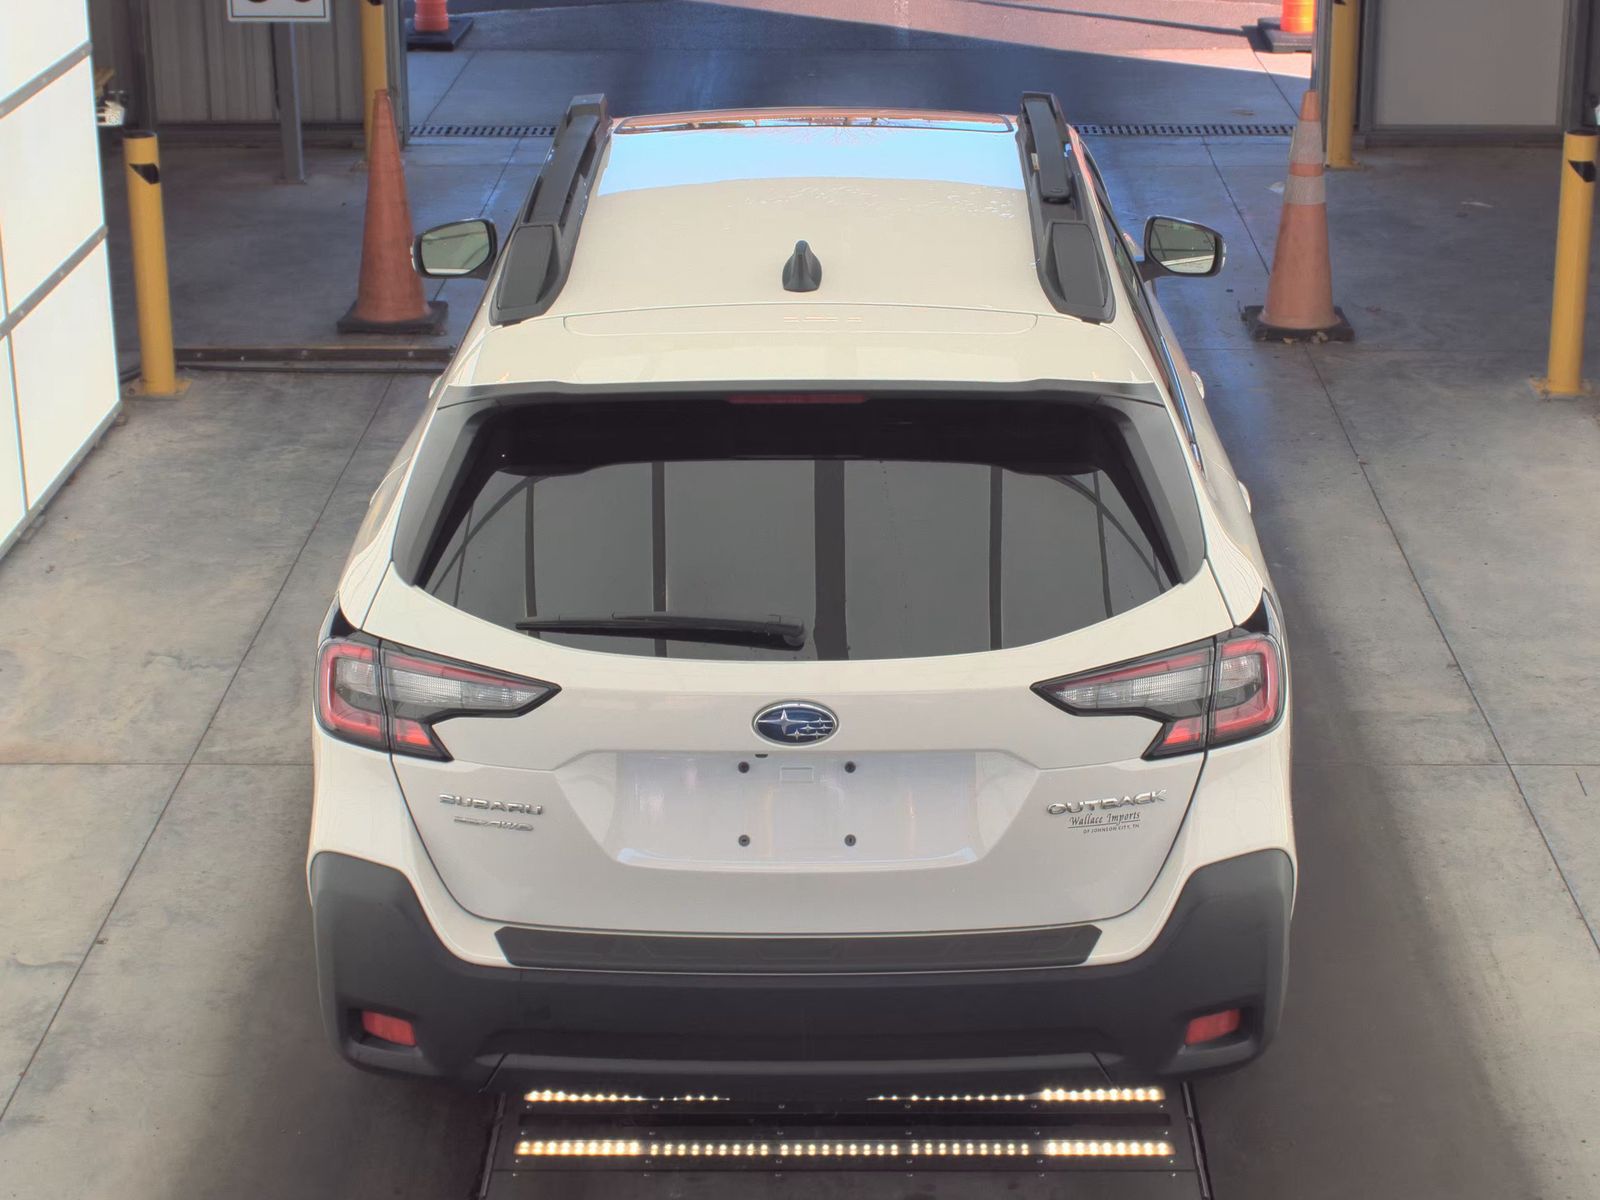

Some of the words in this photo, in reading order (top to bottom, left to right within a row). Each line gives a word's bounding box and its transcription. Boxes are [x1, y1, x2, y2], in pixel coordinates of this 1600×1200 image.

[439, 793, 544, 815] SUBARU
[1046, 789, 1168, 815] OUTBACK
[1069, 812, 1103, 826] Wallace
[1107, 811, 1141, 826] Imports
[1091, 826, 1118, 834] JOHNSON
